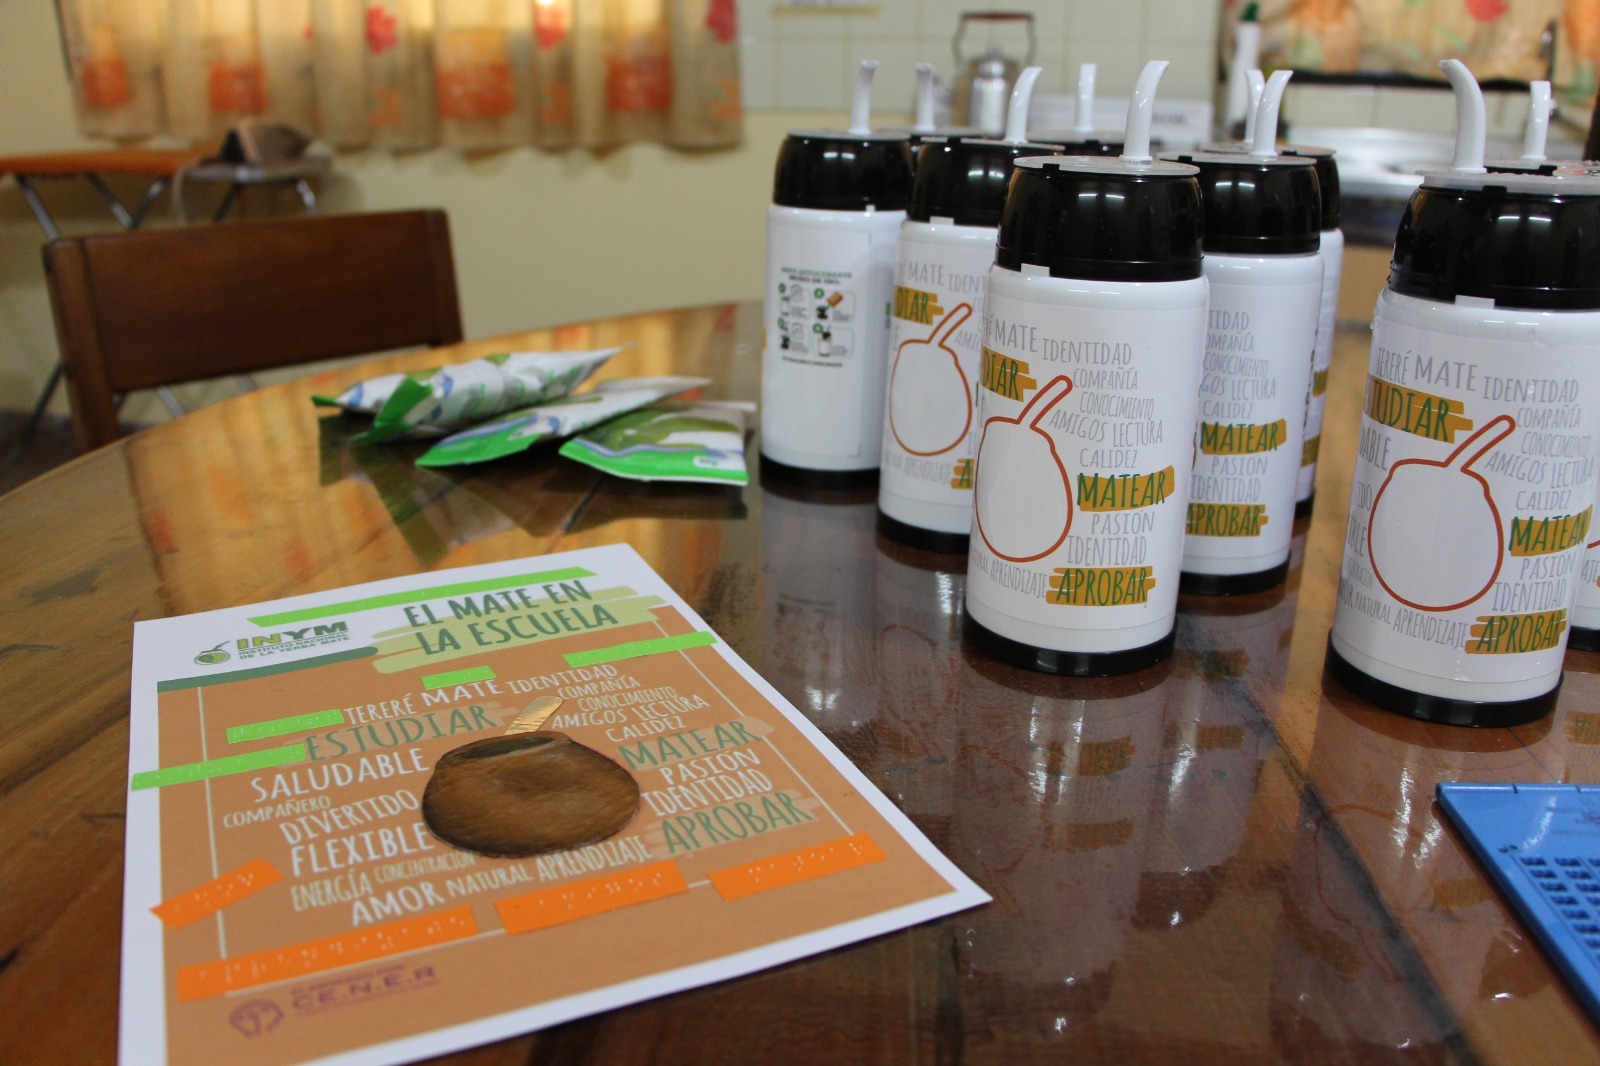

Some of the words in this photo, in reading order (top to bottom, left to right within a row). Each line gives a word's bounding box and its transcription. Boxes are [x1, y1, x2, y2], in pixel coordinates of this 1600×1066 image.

[908, 262, 944, 286] MATE
[995, 318, 1038, 352] MATE
[1042, 337, 1132, 366] IDENTIDAD
[1073, 367, 1138, 390] COMPAÑÍA
[1203, 351, 1269, 378] CONOCIMIENTO
[1376, 347, 1412, 386] TERERÉ
[1414, 354, 1478, 392] MATE
[1482, 375, 1579, 405] IDENTIDAD
[1080, 391, 1155, 420] CONOCIMIENTO
[1231, 377, 1276, 401] LECTURA
[1203, 400, 1254, 419] CALIDEZ
[1517, 404, 1581, 430] COMPAÑÍA
[1049, 409, 1108, 443] AMIGOS
[1113, 419, 1163, 448] LECTURA
[1200, 421, 1278, 452] MATEAR
[1521, 431, 1592, 459] CONOCIMIENTO
[1080, 448, 1138, 469] CALIDEZ
[1211, 454, 1268, 476] PASIÓN
[1484, 451, 1546, 484] AMIGOS
[1551, 457, 1594, 490] LECTURA
[1077, 471, 1166, 508] MATEAR
[1190, 473, 1261, 502] IDENTIDAD
[1516, 489, 1571, 511] CALIDEZ
[1091, 510, 1155, 535] PASIÓN
[1187, 502, 1261, 537] APROBAR
[1509, 510, 1588, 552] MATEAR
[1067, 535, 1147, 566] IDENTIDAD
[1520, 551, 1575, 581] PASIÓN
[990, 559, 1047, 599] APRENDIZAJE
[1056, 567, 1147, 606] APROBAR
[1491, 579, 1567, 612] IDENTIDAD
[403, 605, 432, 627] EL
[447, 587, 541, 621] MATE
[547, 579, 592, 605] EN
[1355, 593, 1391, 626] NATURAL
[1392, 610, 1469, 649] APRENDIZAJE
[237, 621, 348, 650] INYM
[278, 642, 317, 653] YERBA
[320, 636, 350, 645] MATE
[415, 628, 461, 656] LA
[472, 604, 618, 646] ESCUELA
[1476, 610, 1562, 653] APROBAR
[239, 642, 294, 656] INSTITUTO
[343, 693, 417, 724] TERERÉ
[420, 679, 503, 707] MATE
[506, 663, 619, 696] IDENTIDAD
[577, 686, 679, 712] CONOCIMIENTO
[552, 709, 628, 731] AMIGOS
[636, 694, 710, 723] LECTURA
[606, 715, 687, 743] CALIDEZ
[305, 705, 500, 763] ESTUDIAR
[617, 720, 763, 772] MATEAR
[251, 748, 430, 804] SALUDABLE
[660, 747, 762, 785] PASIÓN
[641, 769, 774, 818] IDENTIDAD
[223, 795, 331, 829] COMPAÑERO
[279, 789, 420, 845] DIVERTIDO
[661, 791, 815, 854] APROBAR
[290, 821, 435, 877] FLEXIBLE
[290, 870, 373, 913] ENERGÍA
[351, 881, 446, 928] AMOR
[446, 863, 533, 900] NATURAL
[535, 836, 654, 883] APRENDIZAJE
